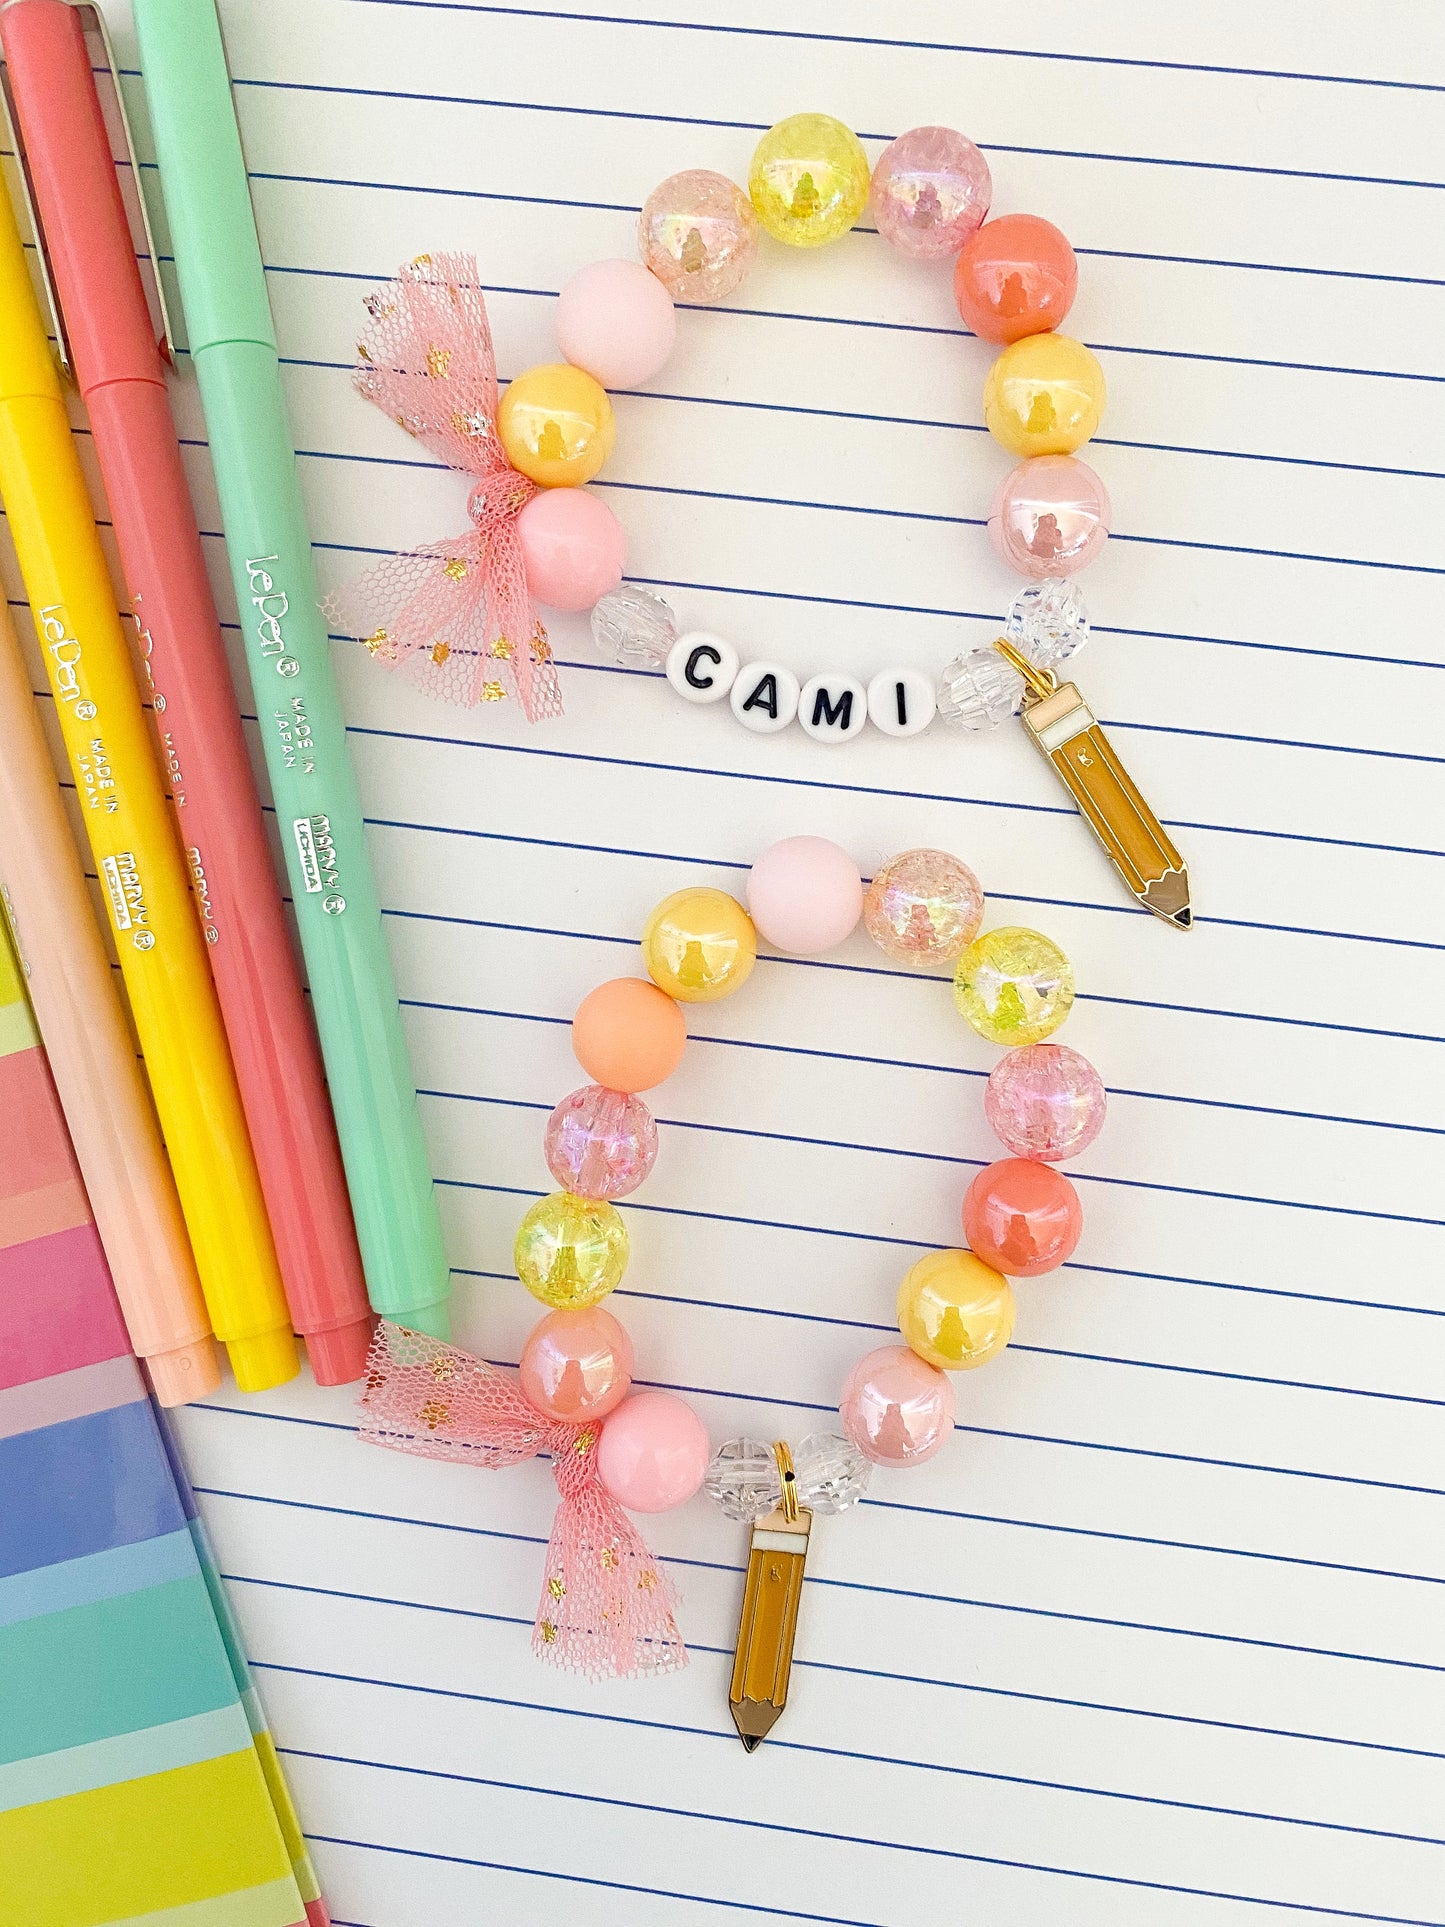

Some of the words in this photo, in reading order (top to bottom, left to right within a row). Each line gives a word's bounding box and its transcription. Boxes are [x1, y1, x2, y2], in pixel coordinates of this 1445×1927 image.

[684, 645, 908, 730] CAMI
[274, 709, 297, 769] JAPAN
[291, 697, 314, 749] MADE
[77, 753, 100, 810] JAPAN
[91, 738, 115, 790] MADE
[104, 795, 119, 814] IN
[163, 732, 182, 784] MADE
[176, 789, 188, 808] IN
[301, 756, 317, 775] IN
